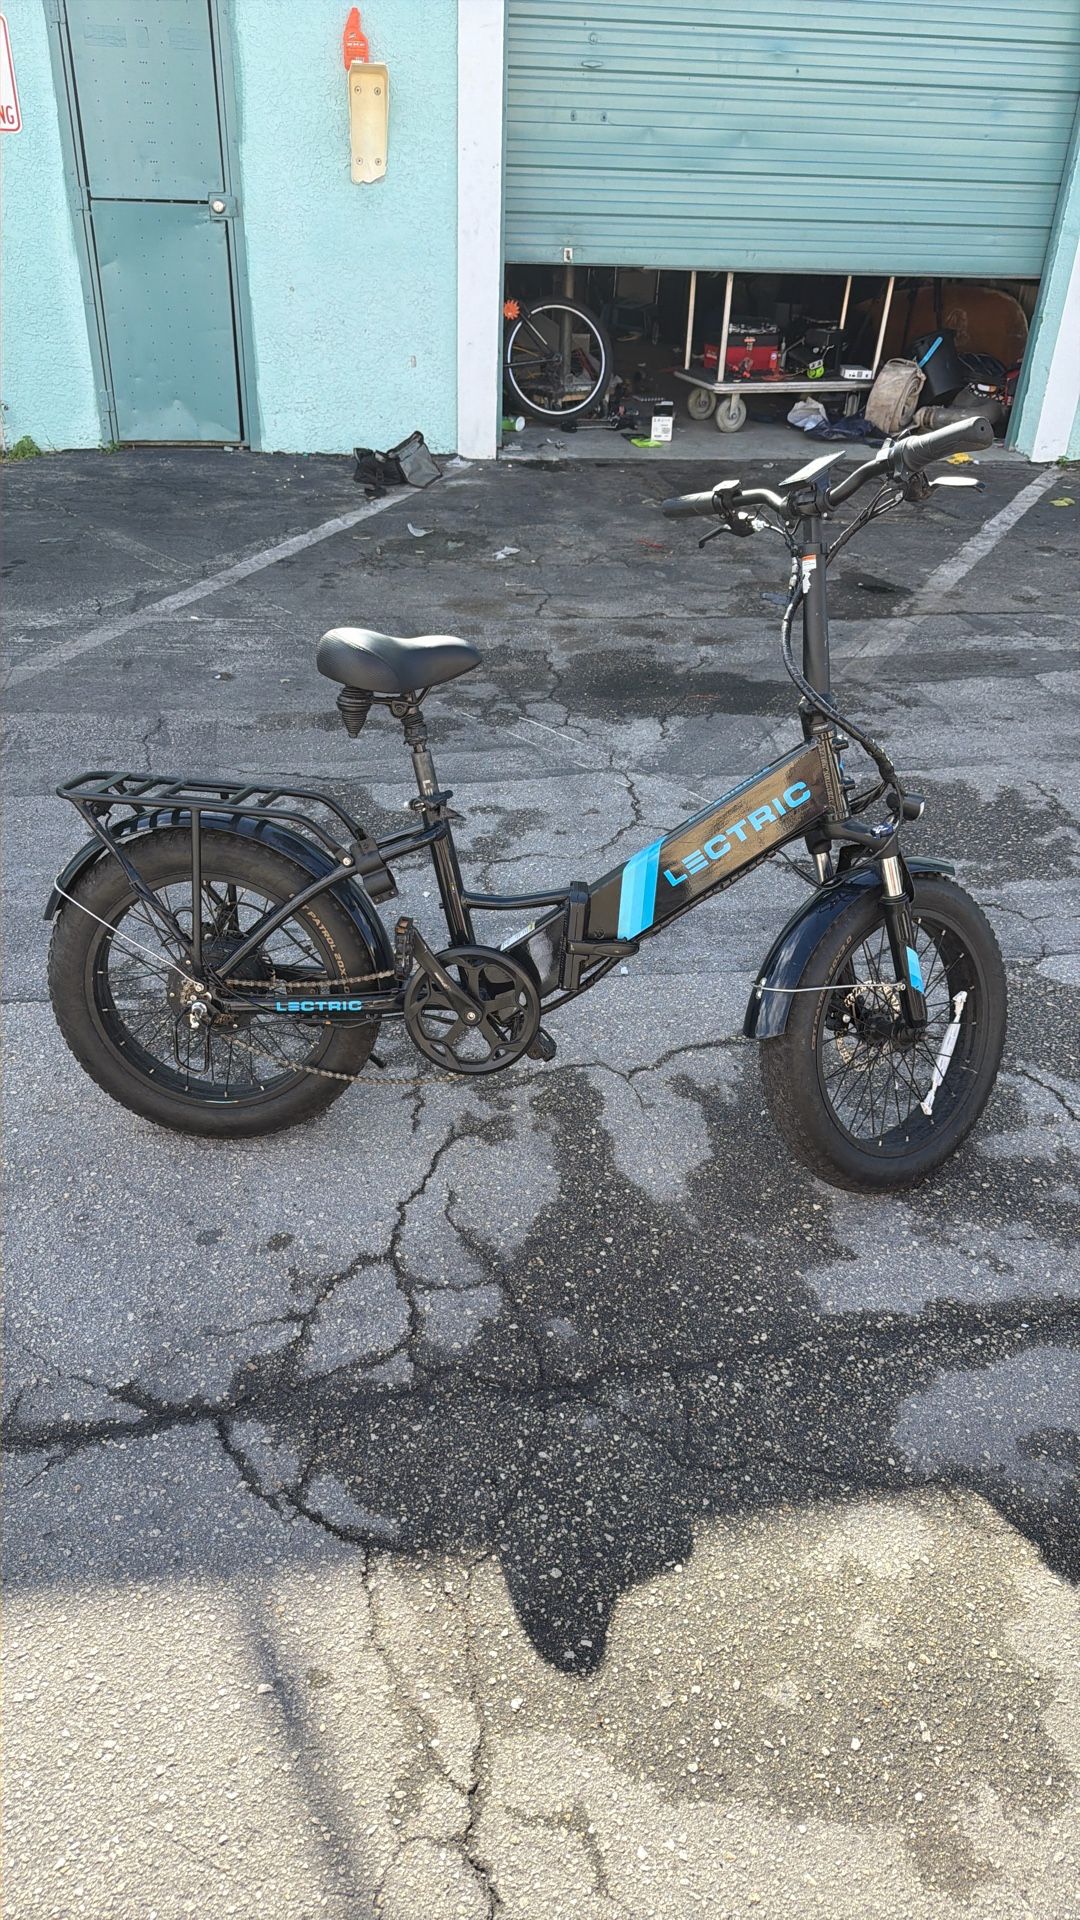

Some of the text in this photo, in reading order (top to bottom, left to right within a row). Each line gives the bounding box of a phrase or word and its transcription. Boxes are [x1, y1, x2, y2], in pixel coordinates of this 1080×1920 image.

[663, 781, 811, 887] LECTRIC
[307, 911, 336, 952] PATROL
[275, 1000, 362, 1012] LECTRIC
